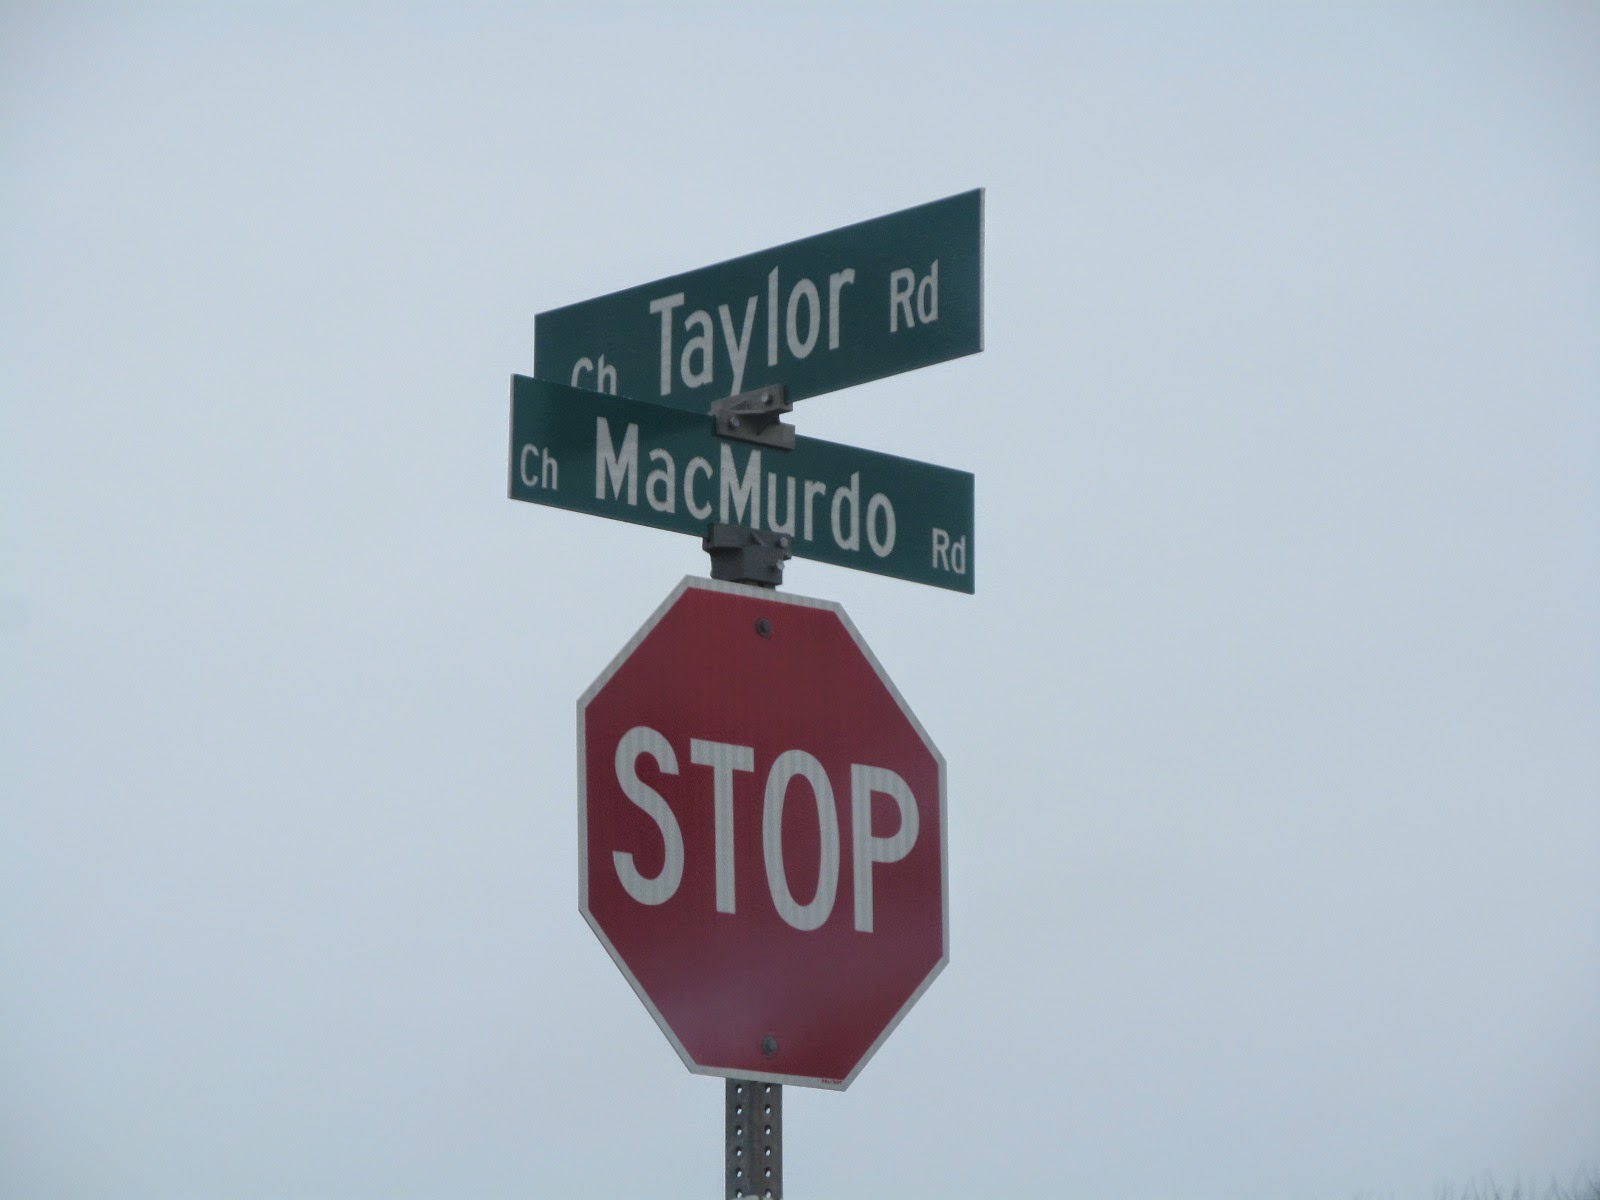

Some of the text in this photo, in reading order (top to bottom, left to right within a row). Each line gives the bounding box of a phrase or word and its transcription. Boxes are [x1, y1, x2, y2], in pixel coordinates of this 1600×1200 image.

[649, 265, 856, 397] Taylor
[889, 259, 940, 333] Rd
[520, 416, 967, 576] Ch MacMurdo Rd
[612, 725, 921, 935] STOP
